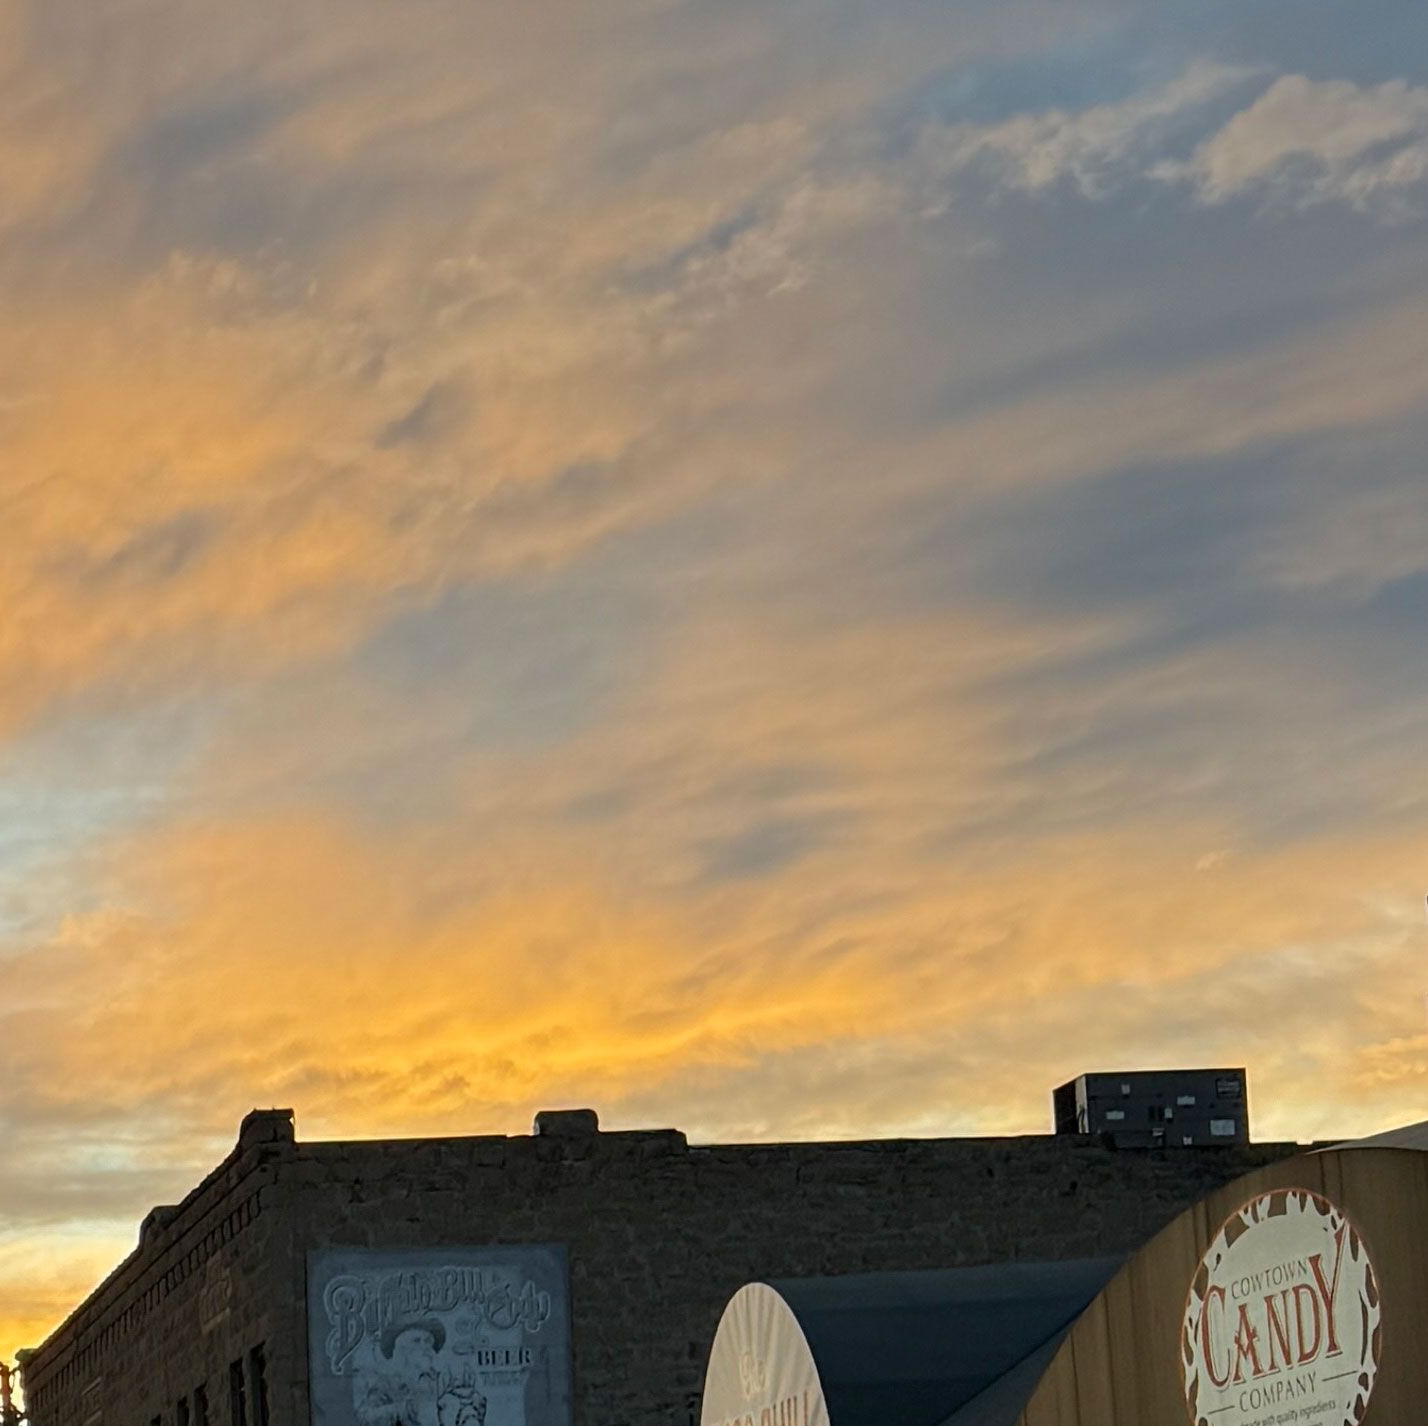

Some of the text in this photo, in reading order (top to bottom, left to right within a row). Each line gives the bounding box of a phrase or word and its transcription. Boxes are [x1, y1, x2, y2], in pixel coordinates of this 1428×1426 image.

[1231, 1259, 1308, 1300] COWTOWN
[1201, 1222, 1347, 1387] CANDY
[1240, 1372, 1316, 1412] COMPANY
